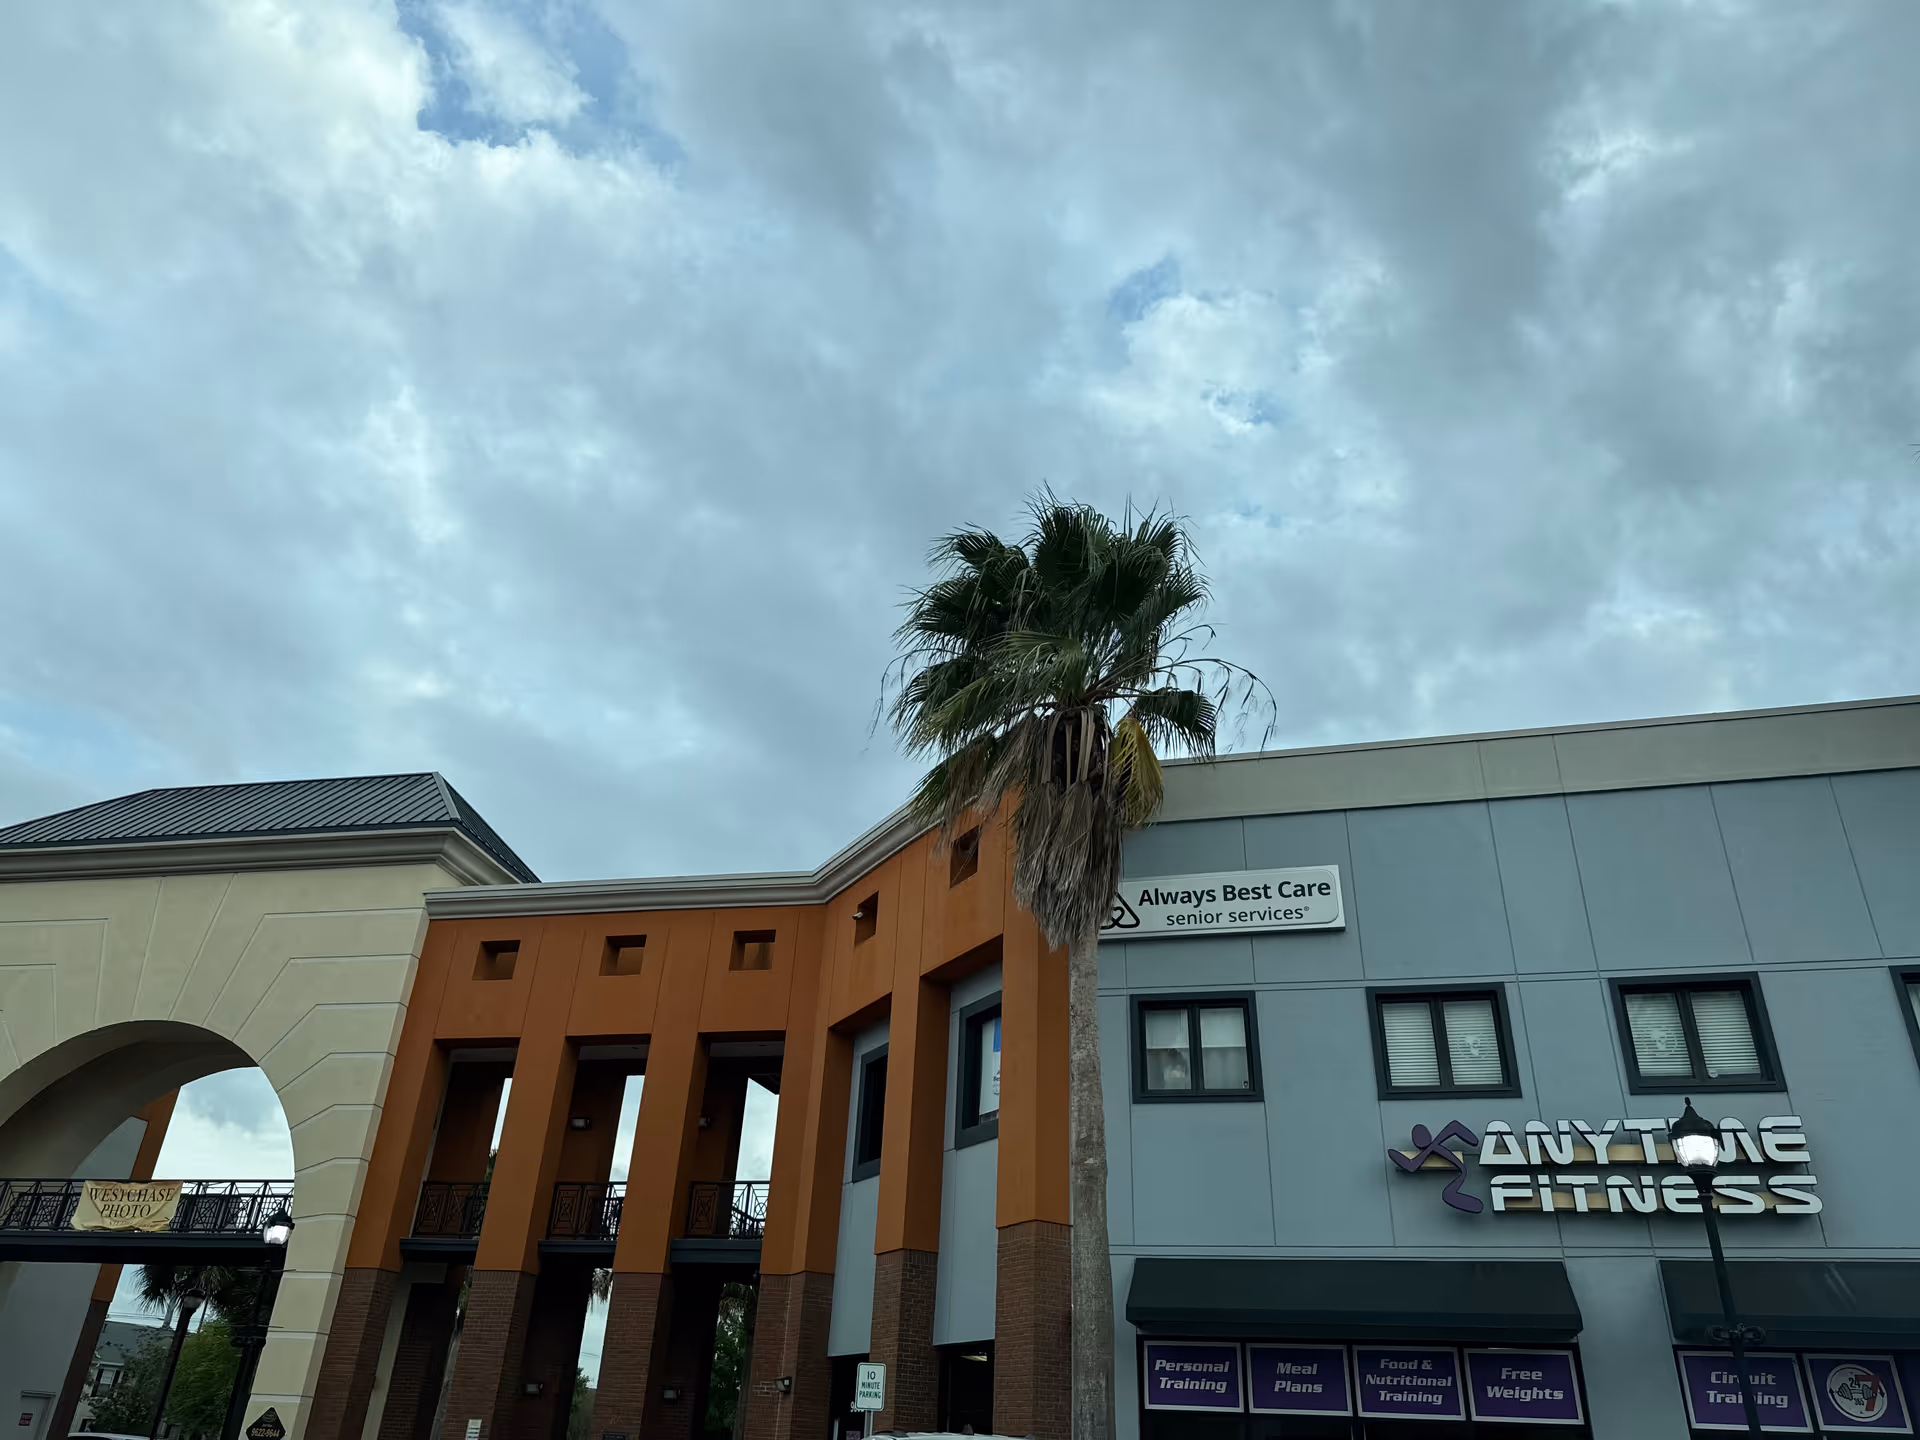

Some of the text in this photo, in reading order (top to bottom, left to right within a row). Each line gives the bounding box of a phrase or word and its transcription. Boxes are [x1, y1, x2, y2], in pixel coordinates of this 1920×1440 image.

[1138, 880, 1332, 908] Always Best Care
[1166, 909, 1223, 926] senior
[1479, 1114, 1812, 1166] ANYTME
[90, 1187, 176, 1203] WESTCHASE
[1490, 1174, 1824, 1215] FITNESS
[101, 1203, 152, 1219] PHOTO
[1154, 1359, 1230, 1373] Personal
[1276, 1361, 1318, 1375] Meal
[1379, 1358, 1433, 1370] Food &
[867, 1371, 876, 1380] 10
[1365, 1373, 1452, 1387] Nutritional
[1501, 1367, 1543, 1380] Free
[1710, 1371, 1776, 1385] Ciruit
[861, 1381, 880, 1389] MINUTE
[1159, 1377, 1227, 1393] Training
[1273, 1380, 1323, 1393] Plans
[859, 1390, 881, 1399] PARKING
[1378, 1390, 1443, 1405] Training
[1486, 1385, 1564, 1402] Weights
[1706, 1390, 1789, 1409] Traiing
